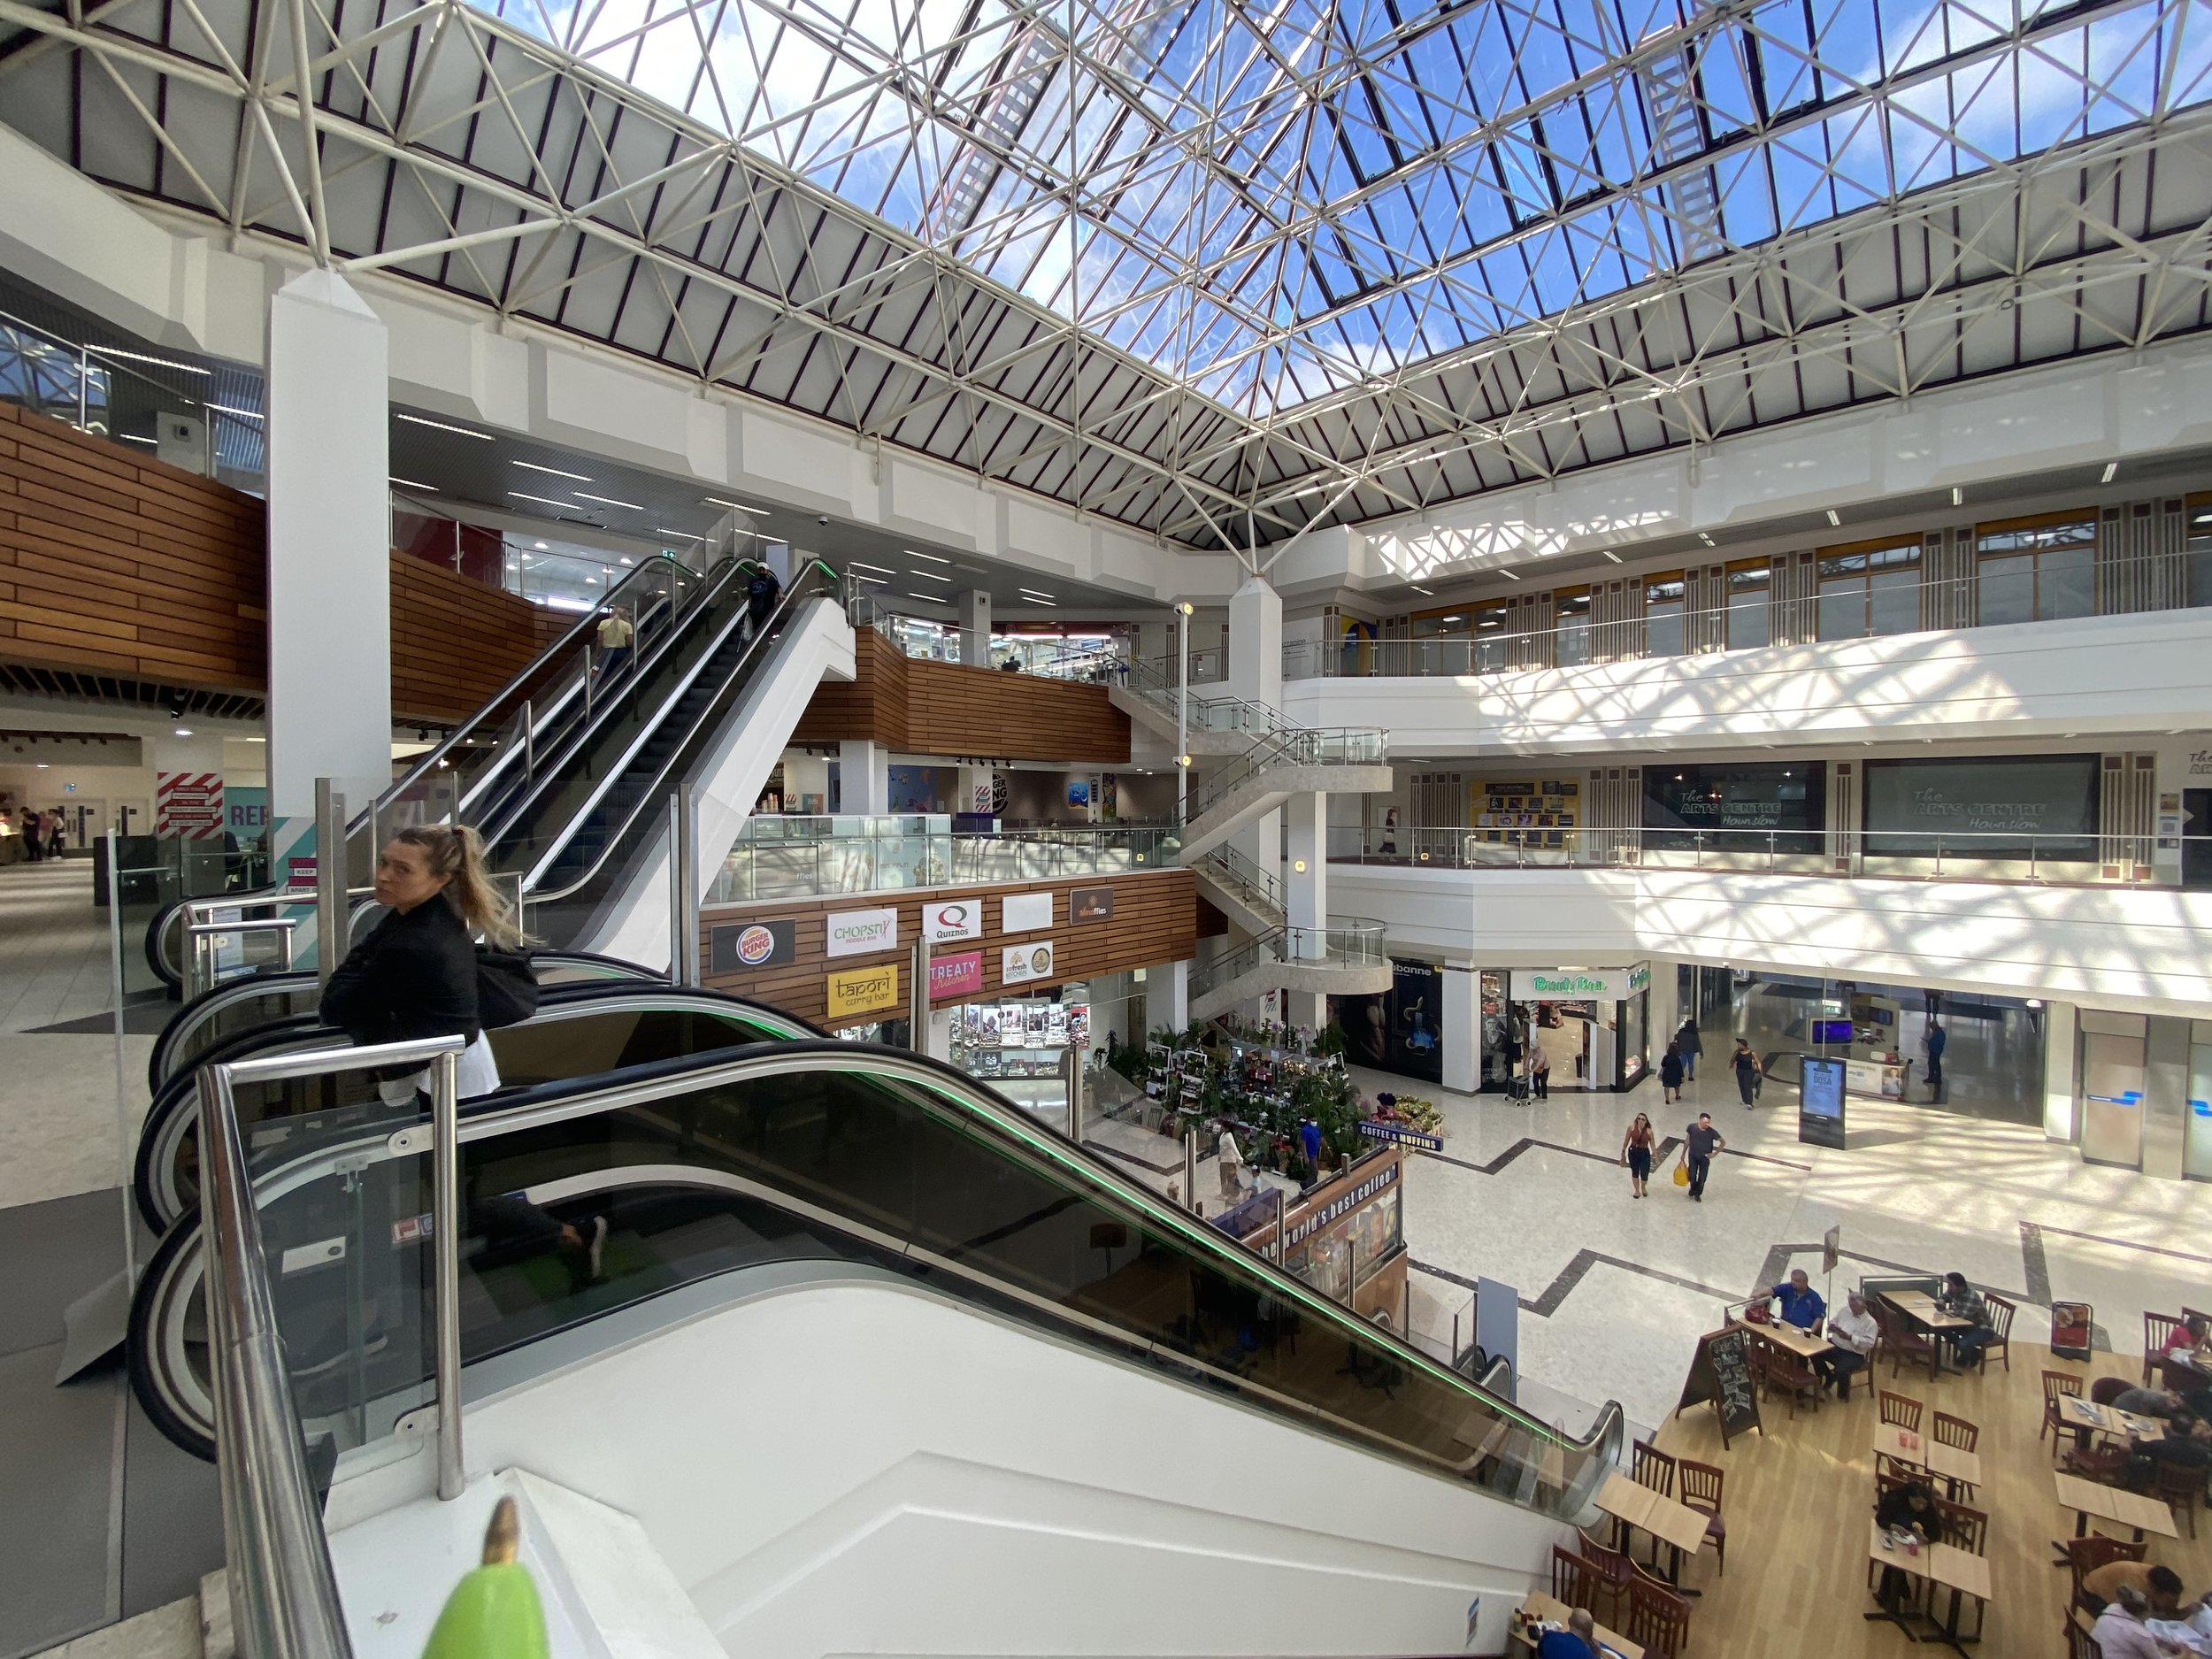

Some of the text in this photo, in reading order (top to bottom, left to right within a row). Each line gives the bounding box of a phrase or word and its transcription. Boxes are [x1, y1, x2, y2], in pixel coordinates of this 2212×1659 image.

[1681, 789, 1704, 803] The
[1914, 787, 1943, 802] The
[1680, 803, 1782, 814] ARTS CENTRE
[1914, 803, 2047, 816] ARTS CENTRE
[1722, 815, 1778, 826] Hounslow
[1968, 818, 2042, 830] Hounslow
[741, 933, 768, 948] BURGER
[741, 939, 770, 957] KING
[930, 961, 976, 980] TREATY
[846, 992, 889, 1007] curry bar
[1362, 1125, 1390, 1139] COFFEE
[1399, 1133, 1436, 1149] MUFFINS
[1330, 1191, 1355, 1219] best
